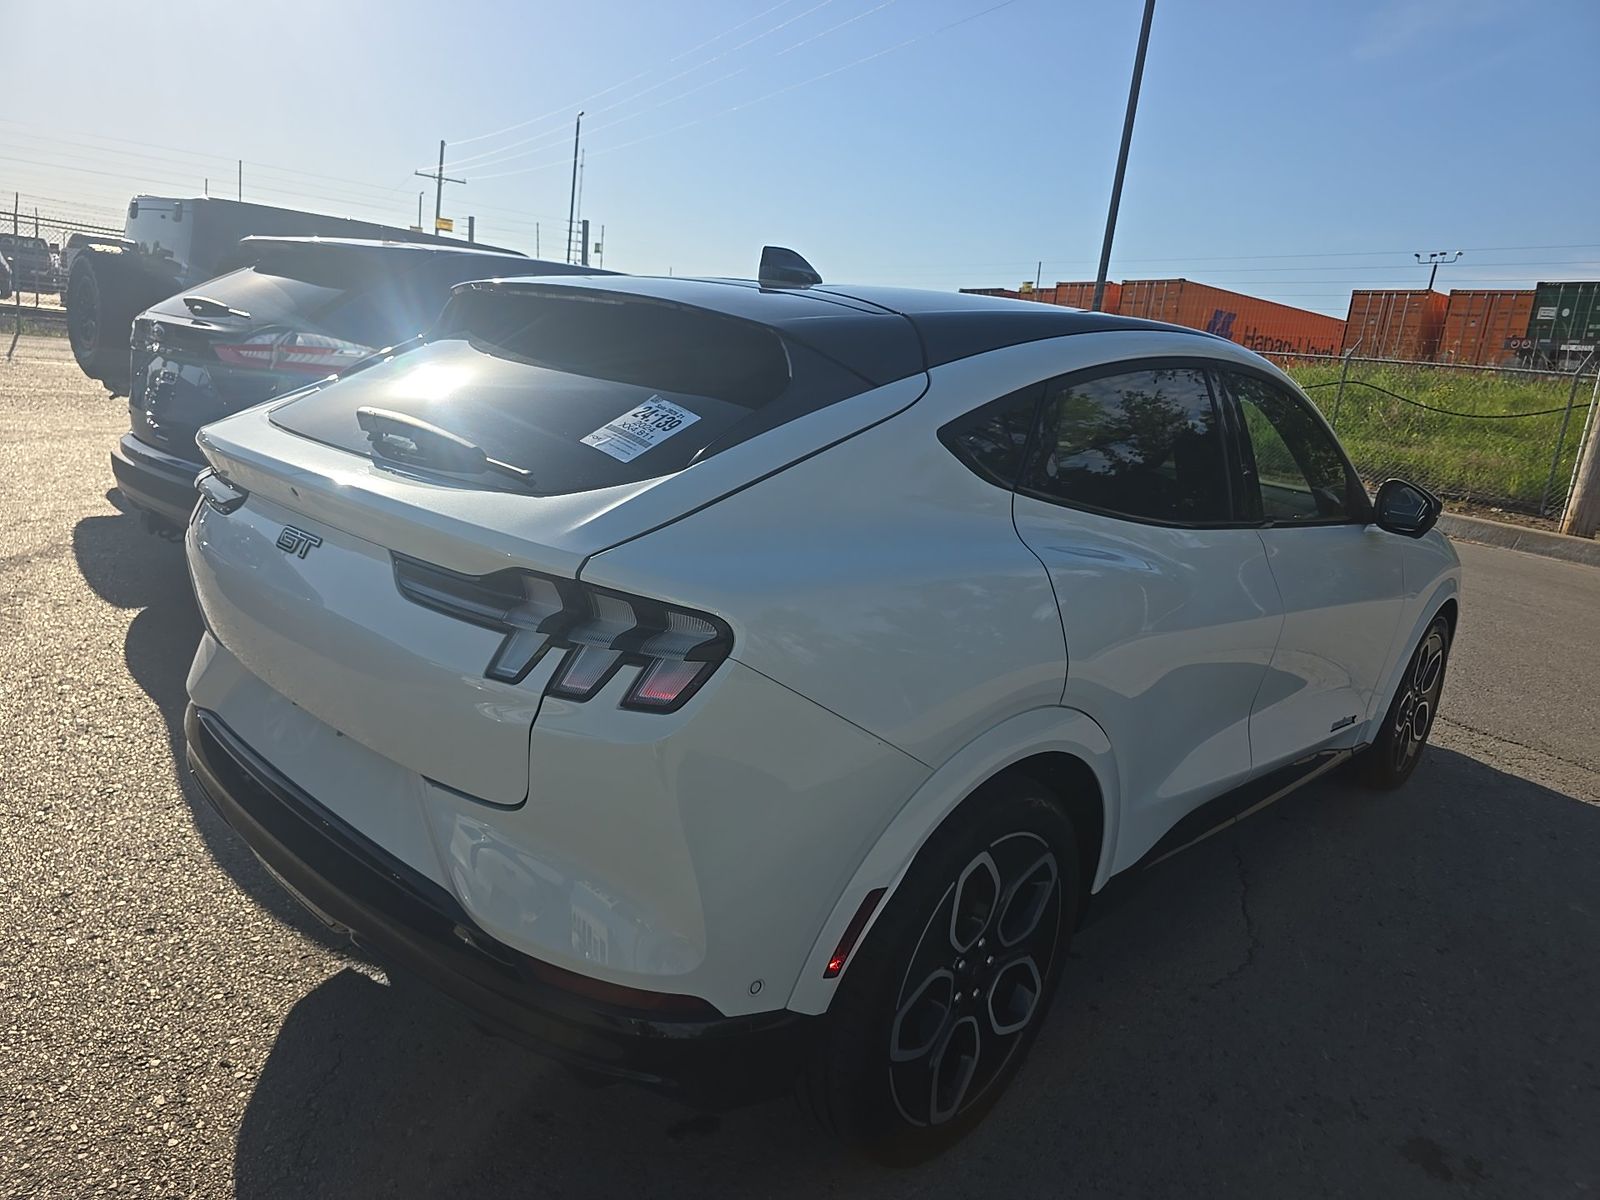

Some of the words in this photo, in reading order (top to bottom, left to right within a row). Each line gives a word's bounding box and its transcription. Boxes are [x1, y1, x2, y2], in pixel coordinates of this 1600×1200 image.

[632, 406, 683, 432] 24:139
[633, 421, 656, 433] 2024
[276, 525, 323, 559] GT
